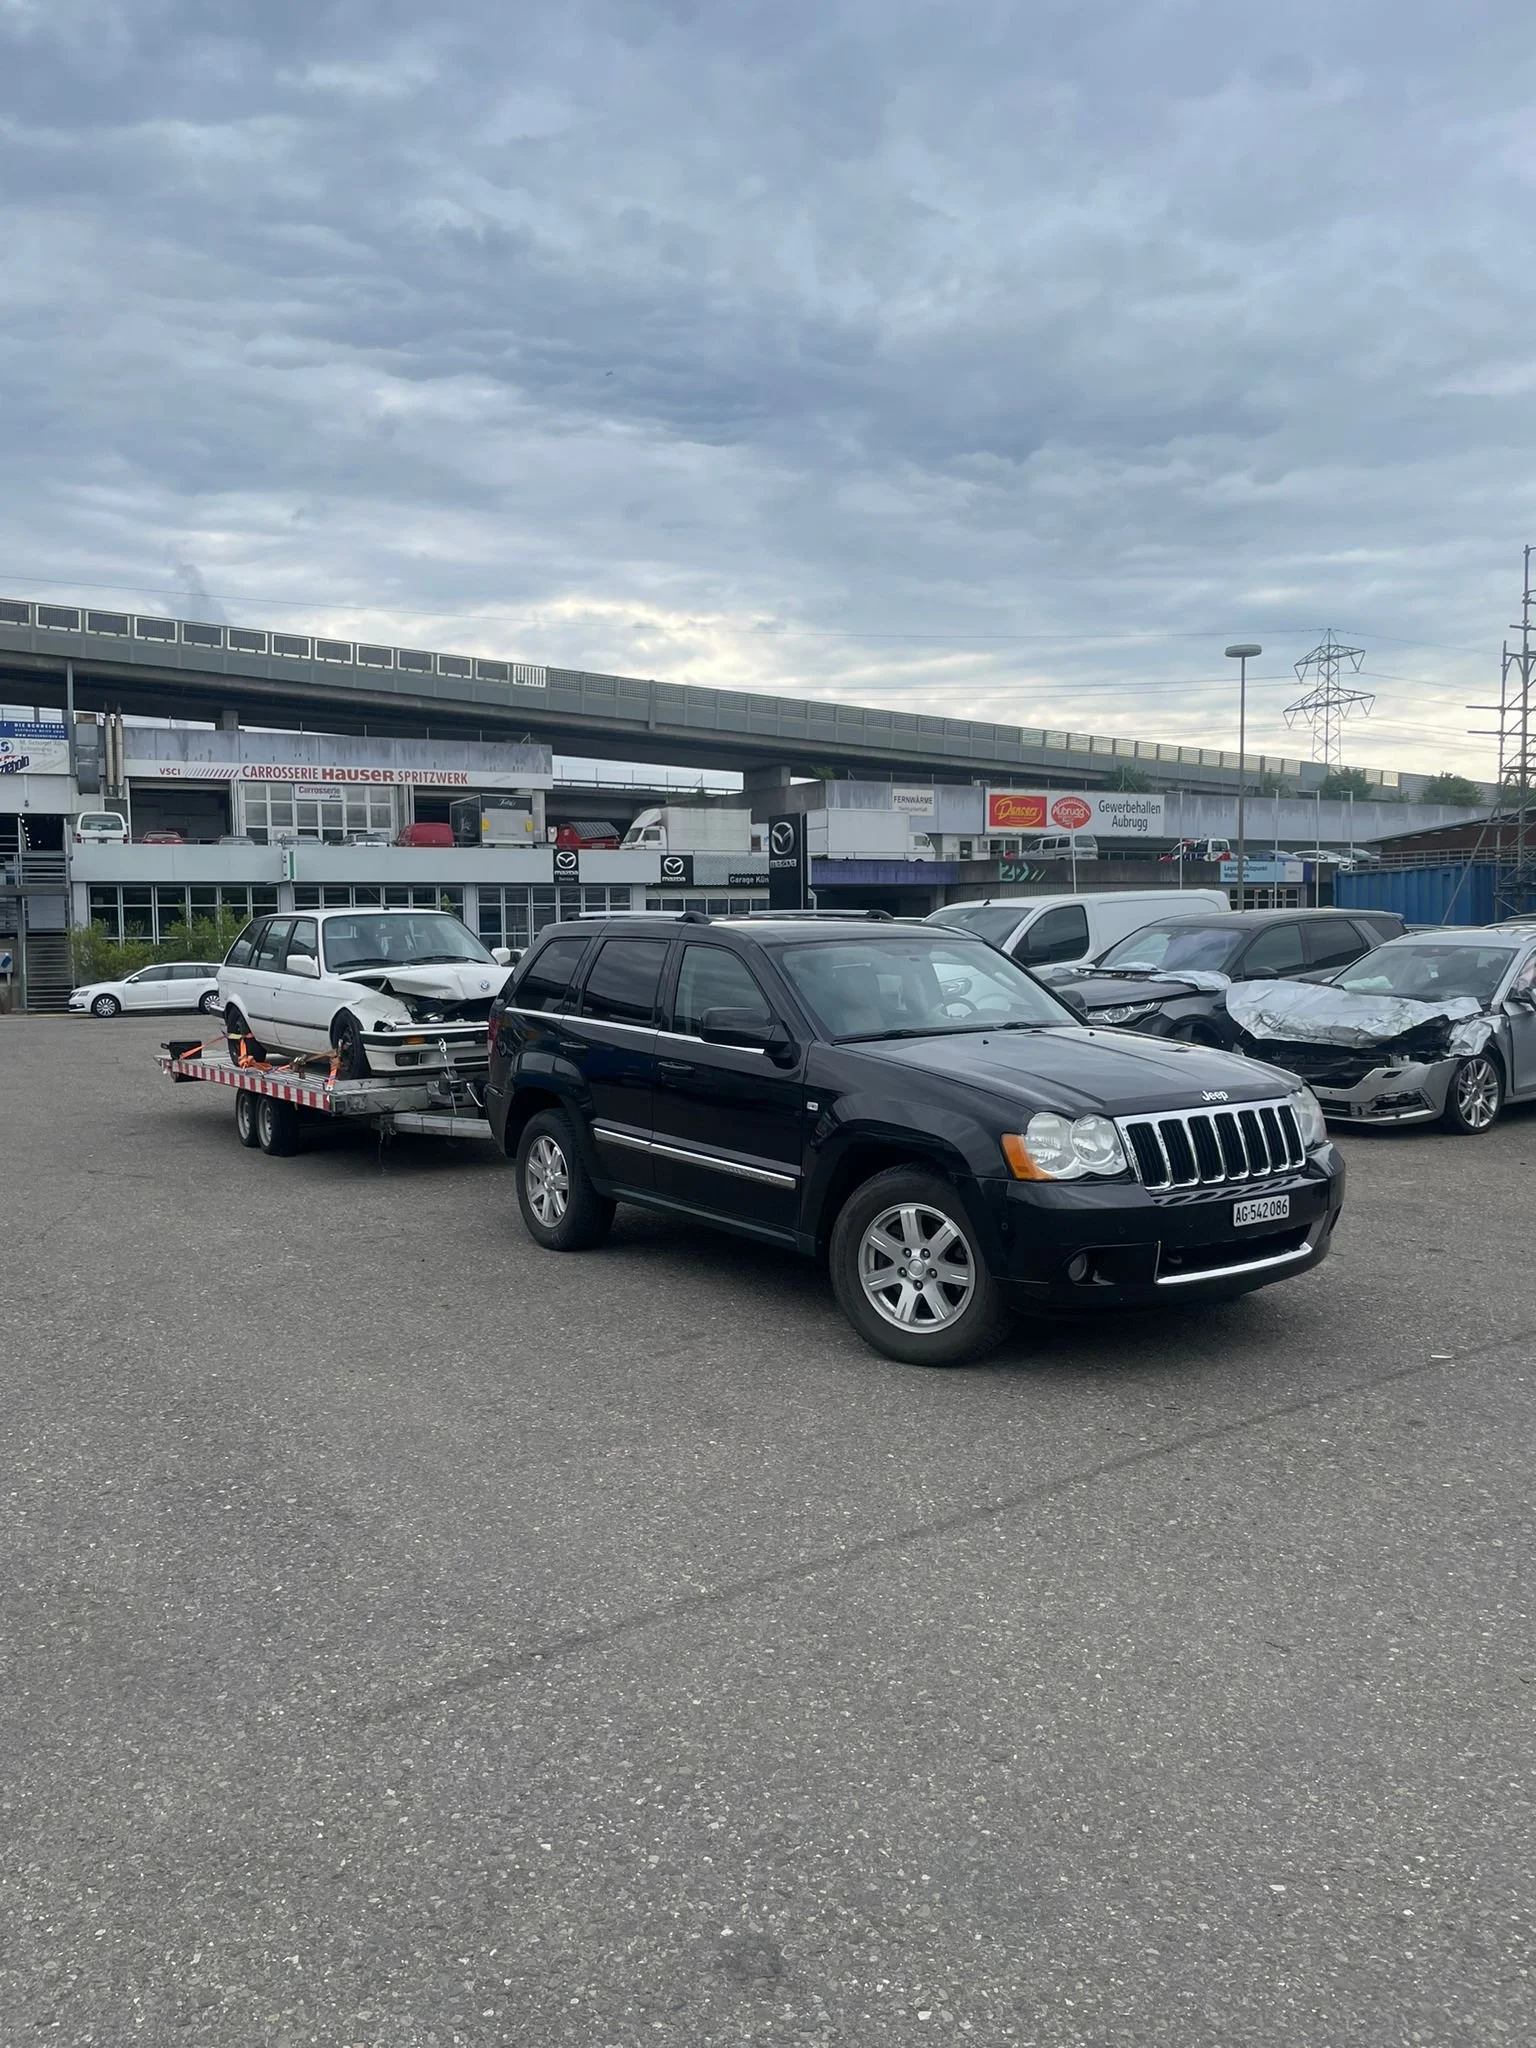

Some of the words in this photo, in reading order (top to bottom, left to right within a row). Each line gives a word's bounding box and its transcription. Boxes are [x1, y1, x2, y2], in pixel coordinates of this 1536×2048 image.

[159, 767, 181, 776] VSCI
[242, 765, 318, 780] CARROSSERIE
[398, 770, 468, 785] SPRITZWERK
[1098, 799, 1161, 814] Gewerbehallen
[1111, 815, 1148, 831] Aubrugg
[769, 858, 797, 869] mazda
[729, 875, 754, 885] Garage
[1201, 1090, 1229, 1102] Jeep
